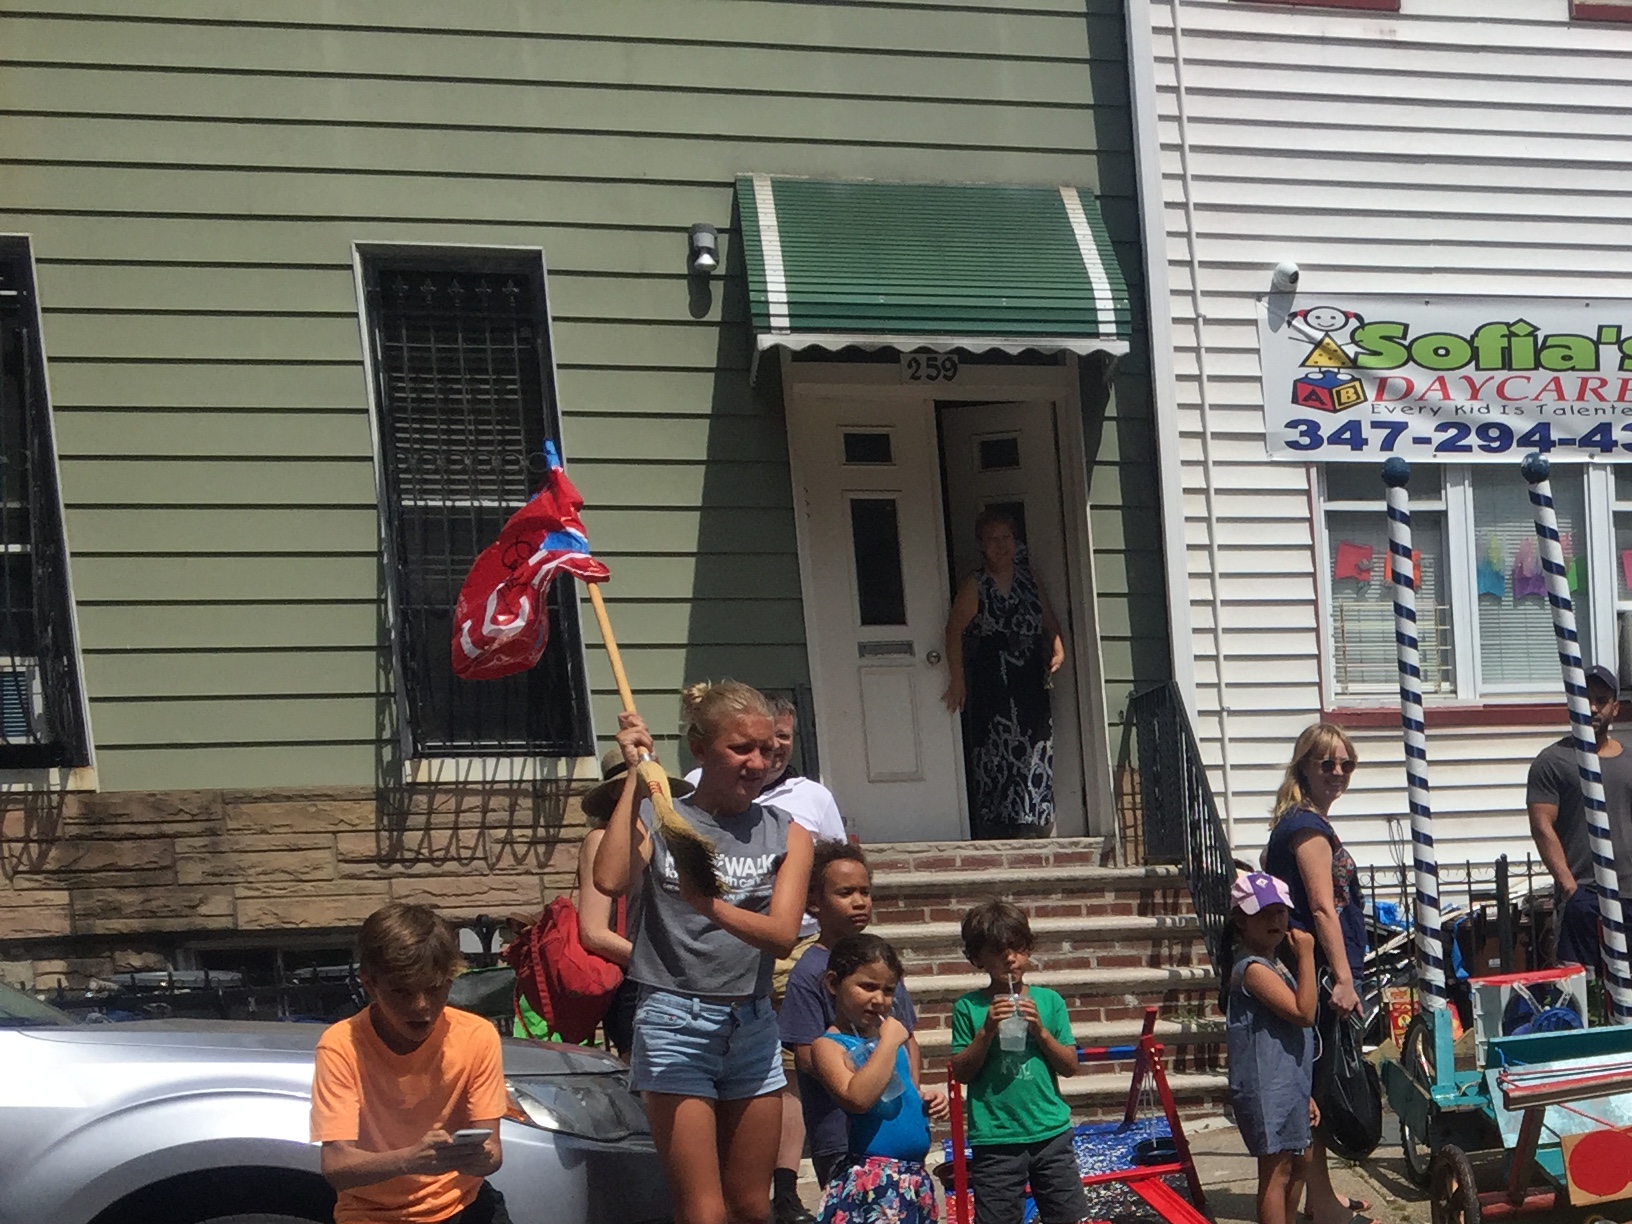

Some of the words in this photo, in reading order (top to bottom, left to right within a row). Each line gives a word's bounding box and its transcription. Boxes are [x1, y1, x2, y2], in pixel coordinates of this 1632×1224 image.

[907, 356, 958, 381] 259
[1302, 388, 1328, 406] A
[1340, 387, 1358, 404] B
[1371, 403, 1443, 417] Every
[1454, 403, 1492, 416] Kid
[1499, 404, 1525, 416] Is
[724, 853, 777, 877] WALK
